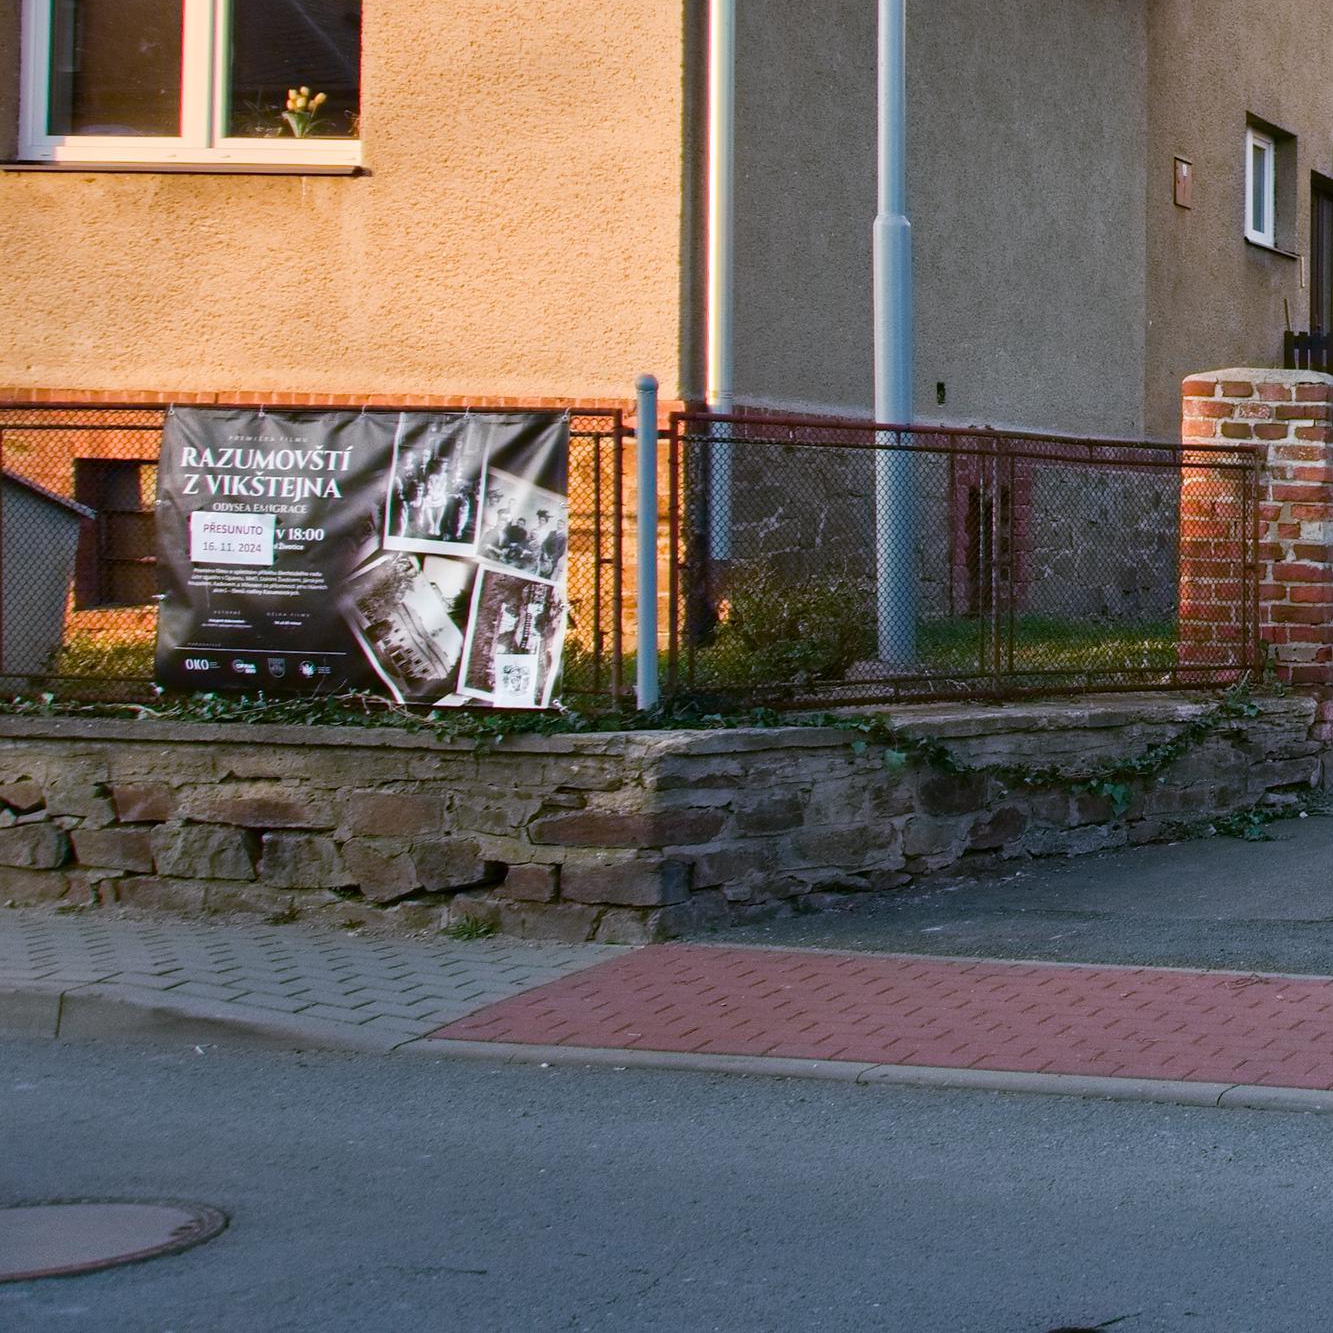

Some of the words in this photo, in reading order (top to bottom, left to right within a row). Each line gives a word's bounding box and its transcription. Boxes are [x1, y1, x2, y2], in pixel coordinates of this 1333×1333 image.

[180, 445, 354, 471] RAZUMOVŠTÍ
[182, 474, 200, 495] Z
[205, 471, 343, 502] VIKŠTEJNA
[212, 502, 251, 513] ODYSEA
[253, 503, 308, 514] EMIGRACE
[203, 522, 264, 536] PŘESUNUTO
[288, 527, 325, 541] 18:00
[203, 541, 218, 551] 16.
[221, 542, 235, 552] 11.
[238, 543, 262, 553] 2024
